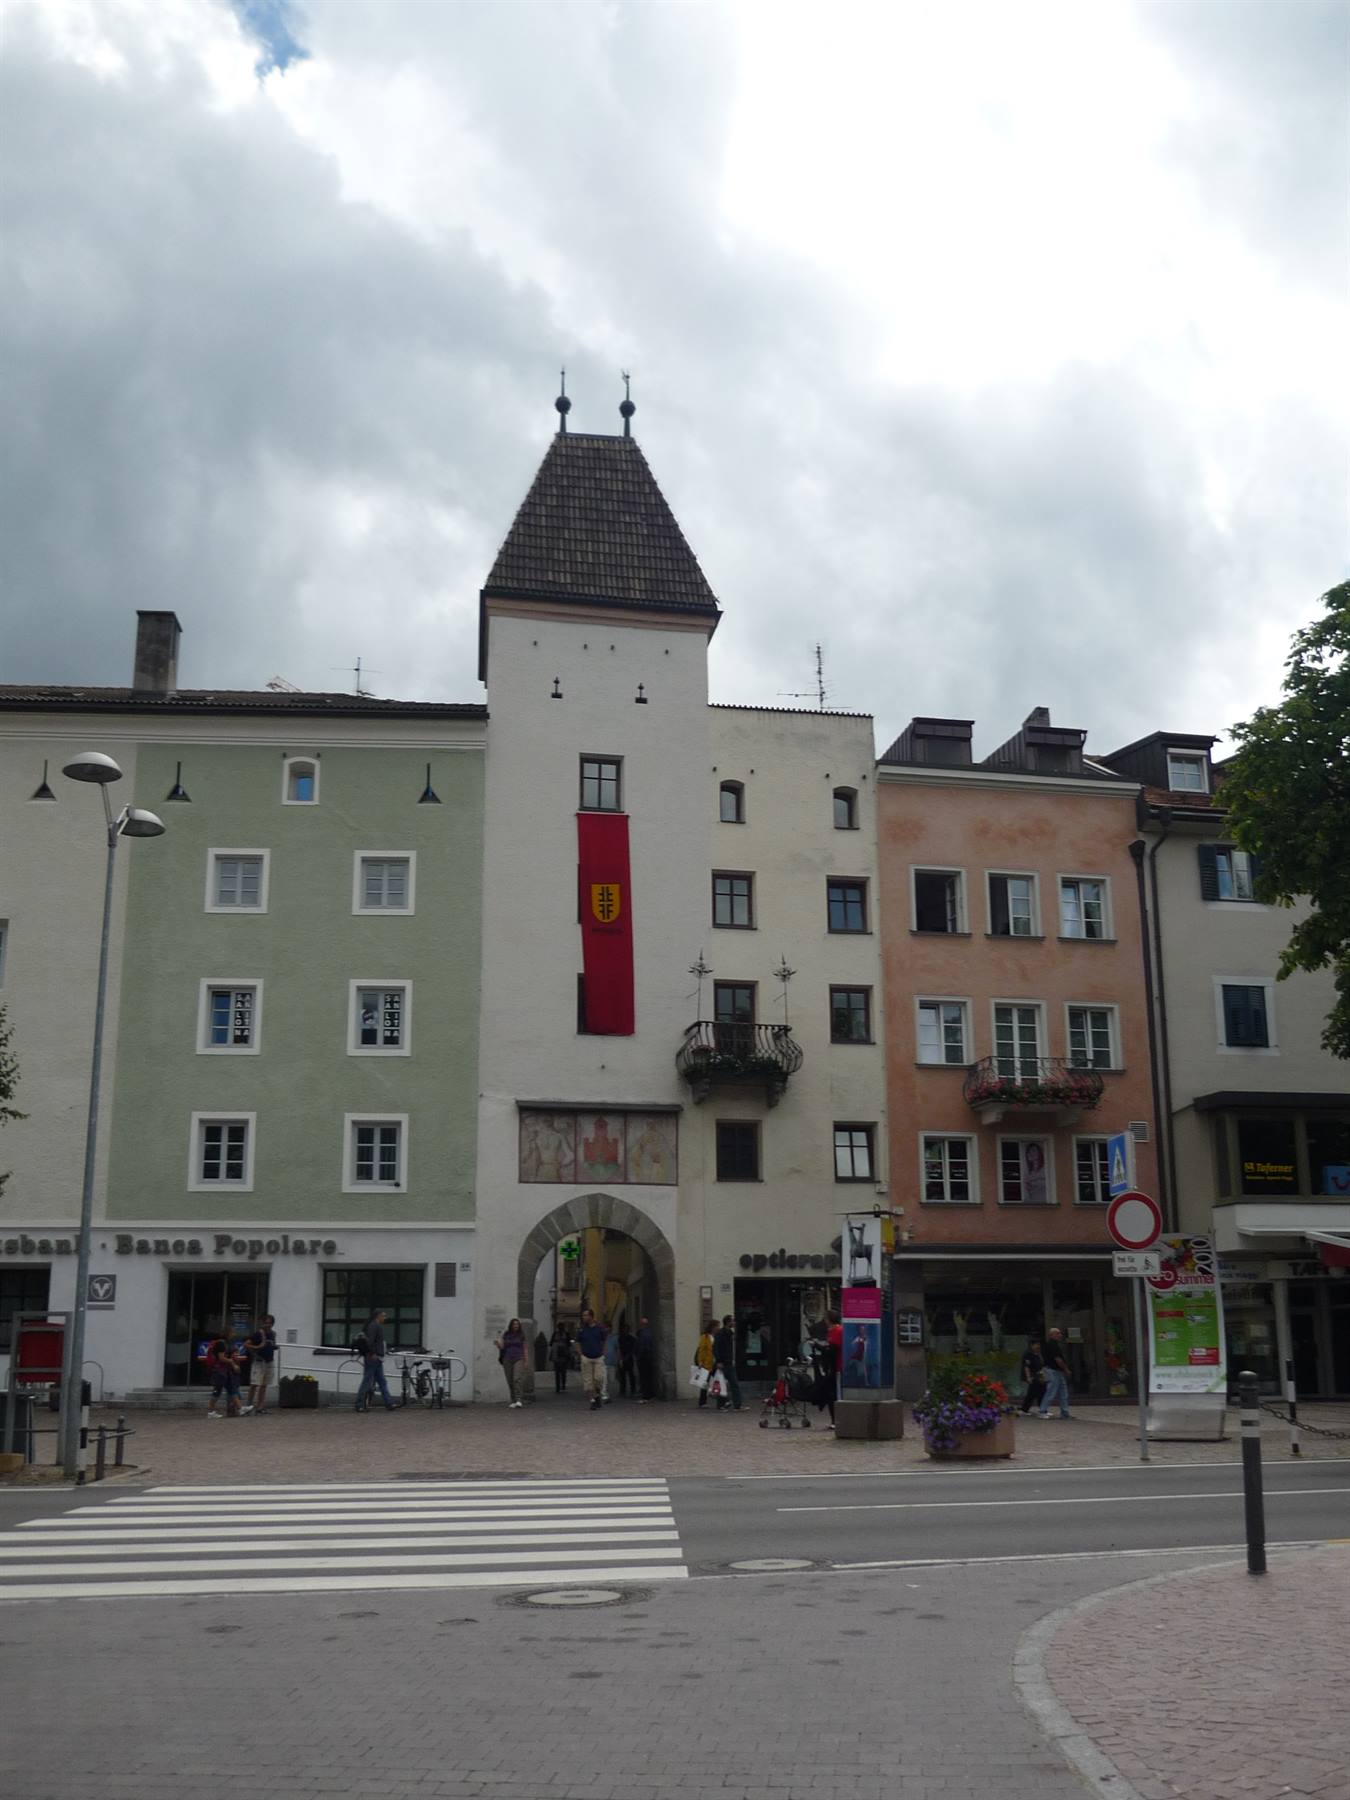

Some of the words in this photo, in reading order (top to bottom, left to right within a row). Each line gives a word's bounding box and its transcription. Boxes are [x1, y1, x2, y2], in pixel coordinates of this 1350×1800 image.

[115, 1234, 203, 1256] Banca
[214, 1234, 337, 1260] Popolare
[1191, 1238, 1215, 1276] 2010
[739, 1248, 842, 1273] opticrap
